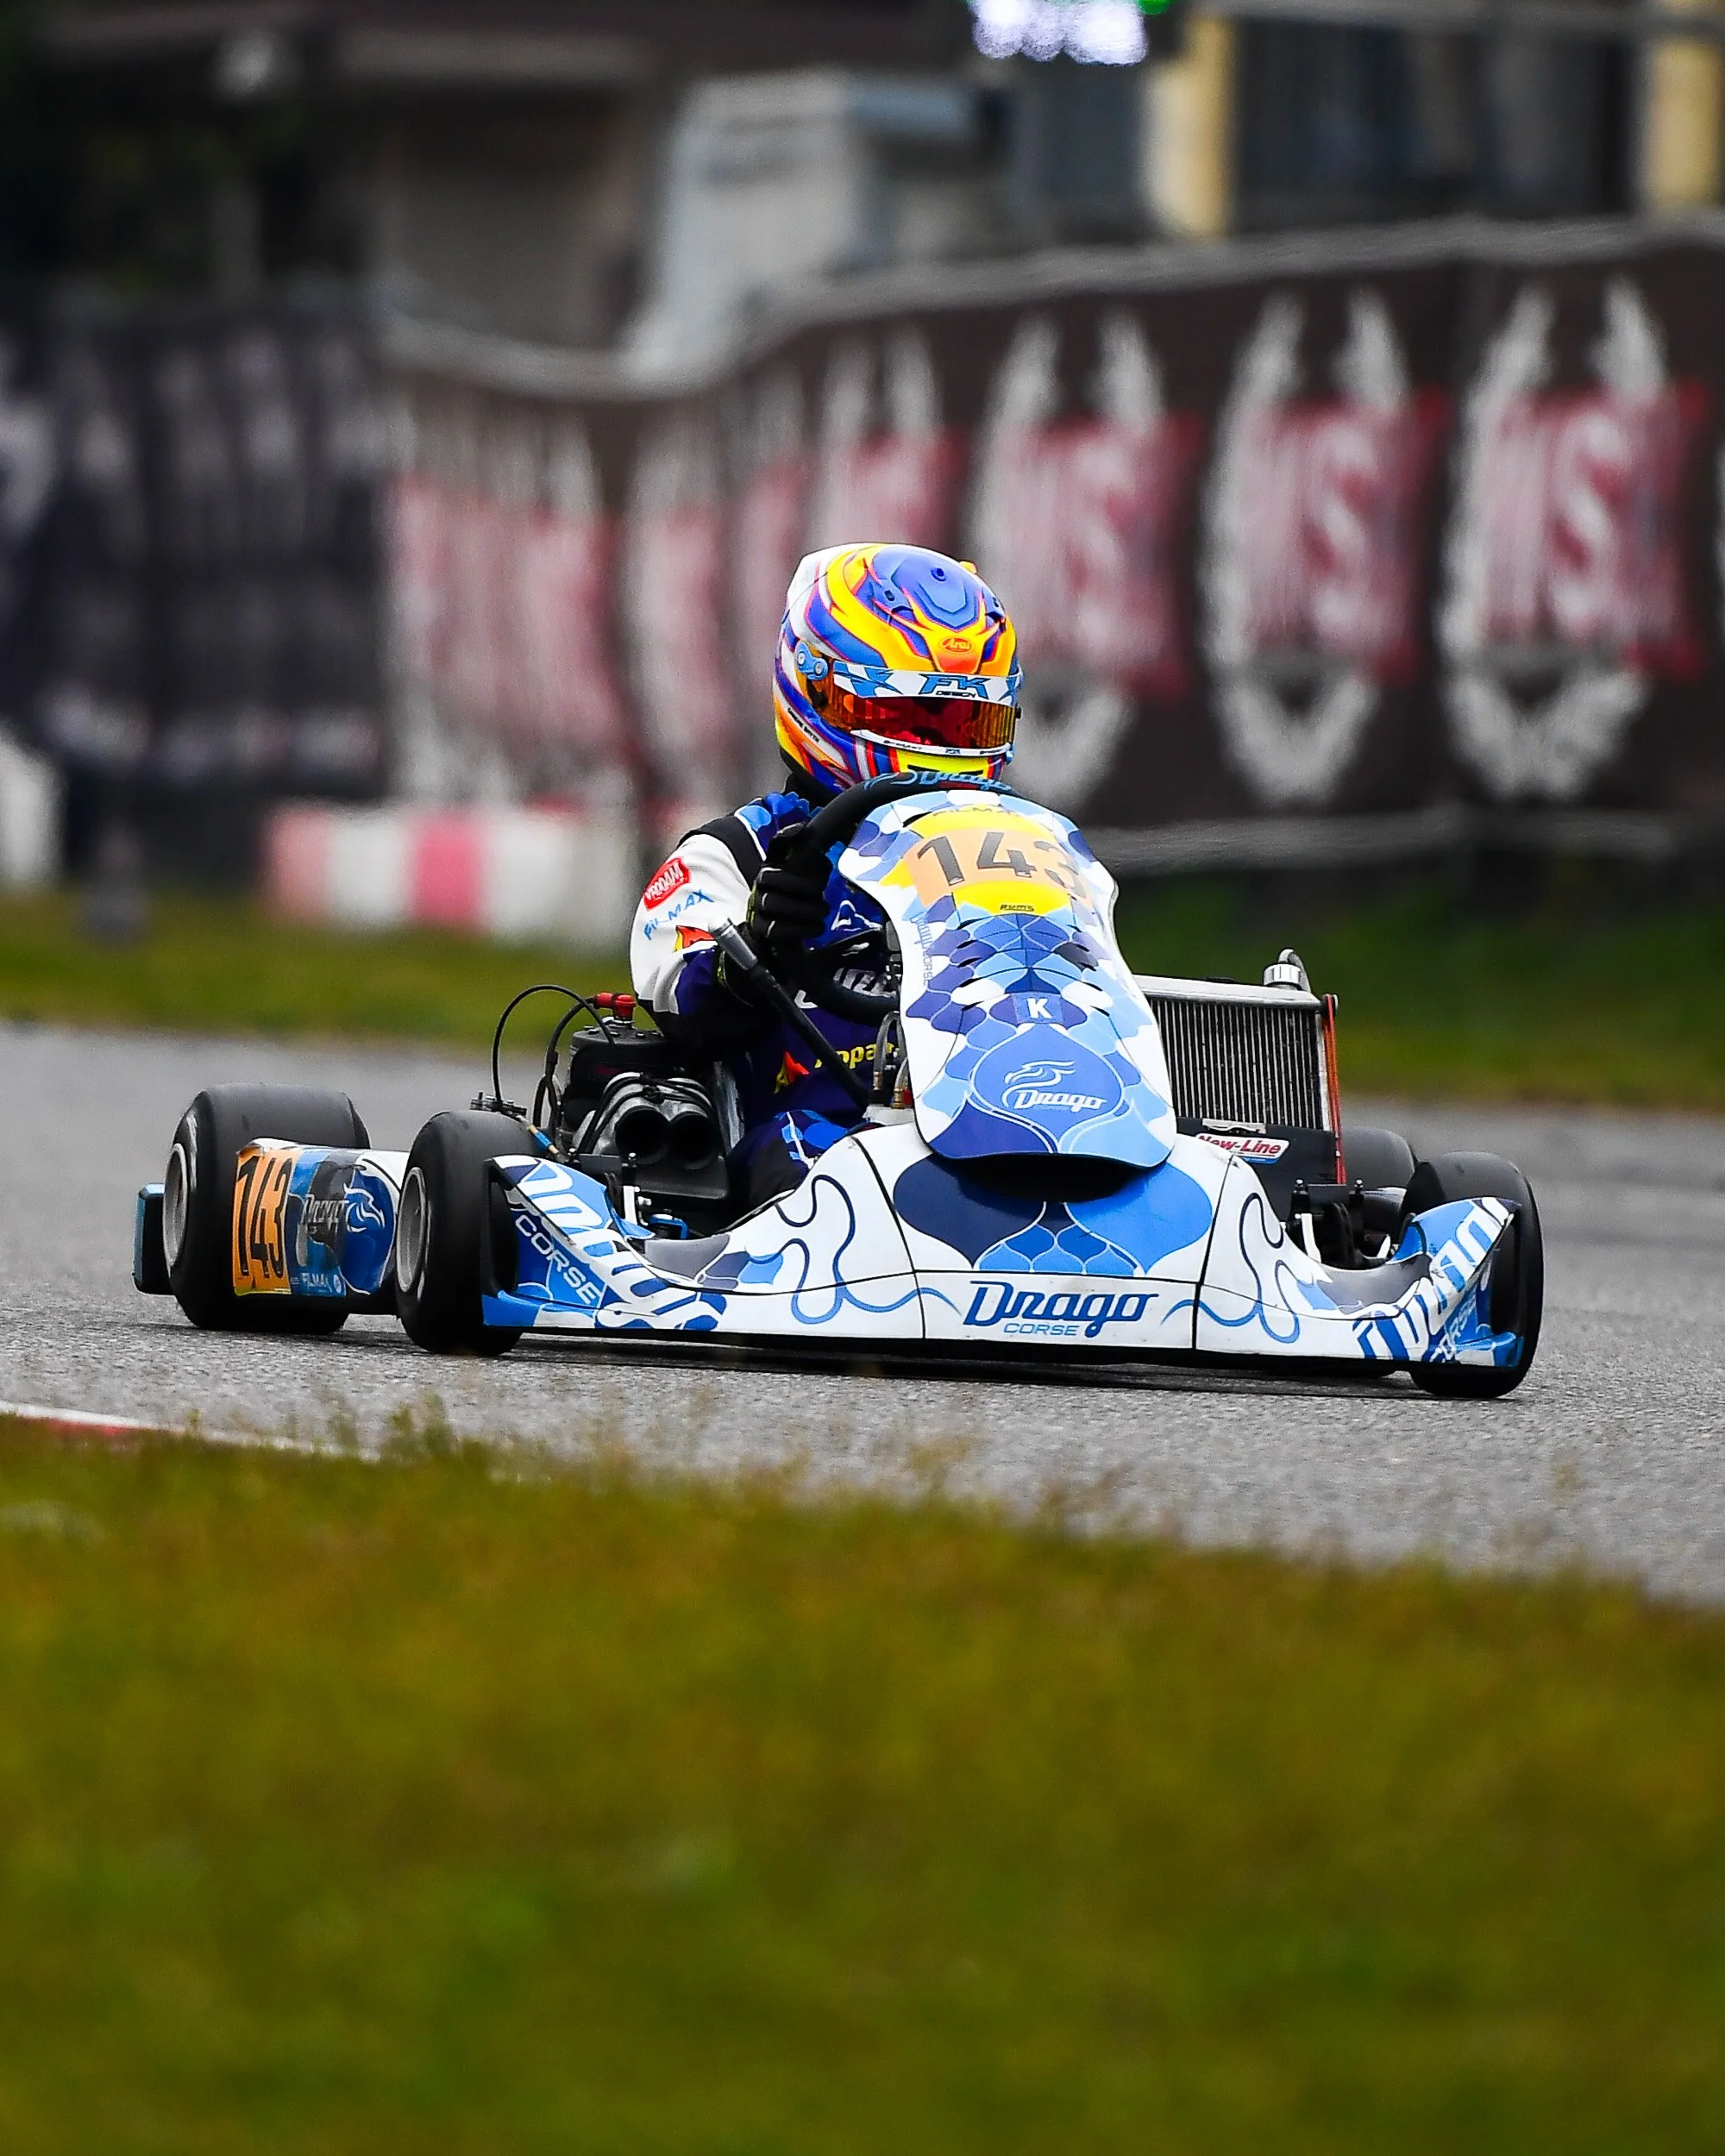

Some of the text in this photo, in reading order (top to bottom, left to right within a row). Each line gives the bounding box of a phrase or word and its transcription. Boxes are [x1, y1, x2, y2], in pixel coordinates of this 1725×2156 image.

[944, 639, 971, 650] Arai
[919, 674, 990, 699] FK
[917, 831, 1086, 899] 143
[1027, 997, 1052, 1019] K
[1013, 1089, 1107, 1112] Drago
[237, 1156, 292, 1278] 143
[516, 1214, 600, 1305] CORSE
[963, 1280, 1159, 1338] Drago
[1003, 1323, 1080, 1336] CORSE
